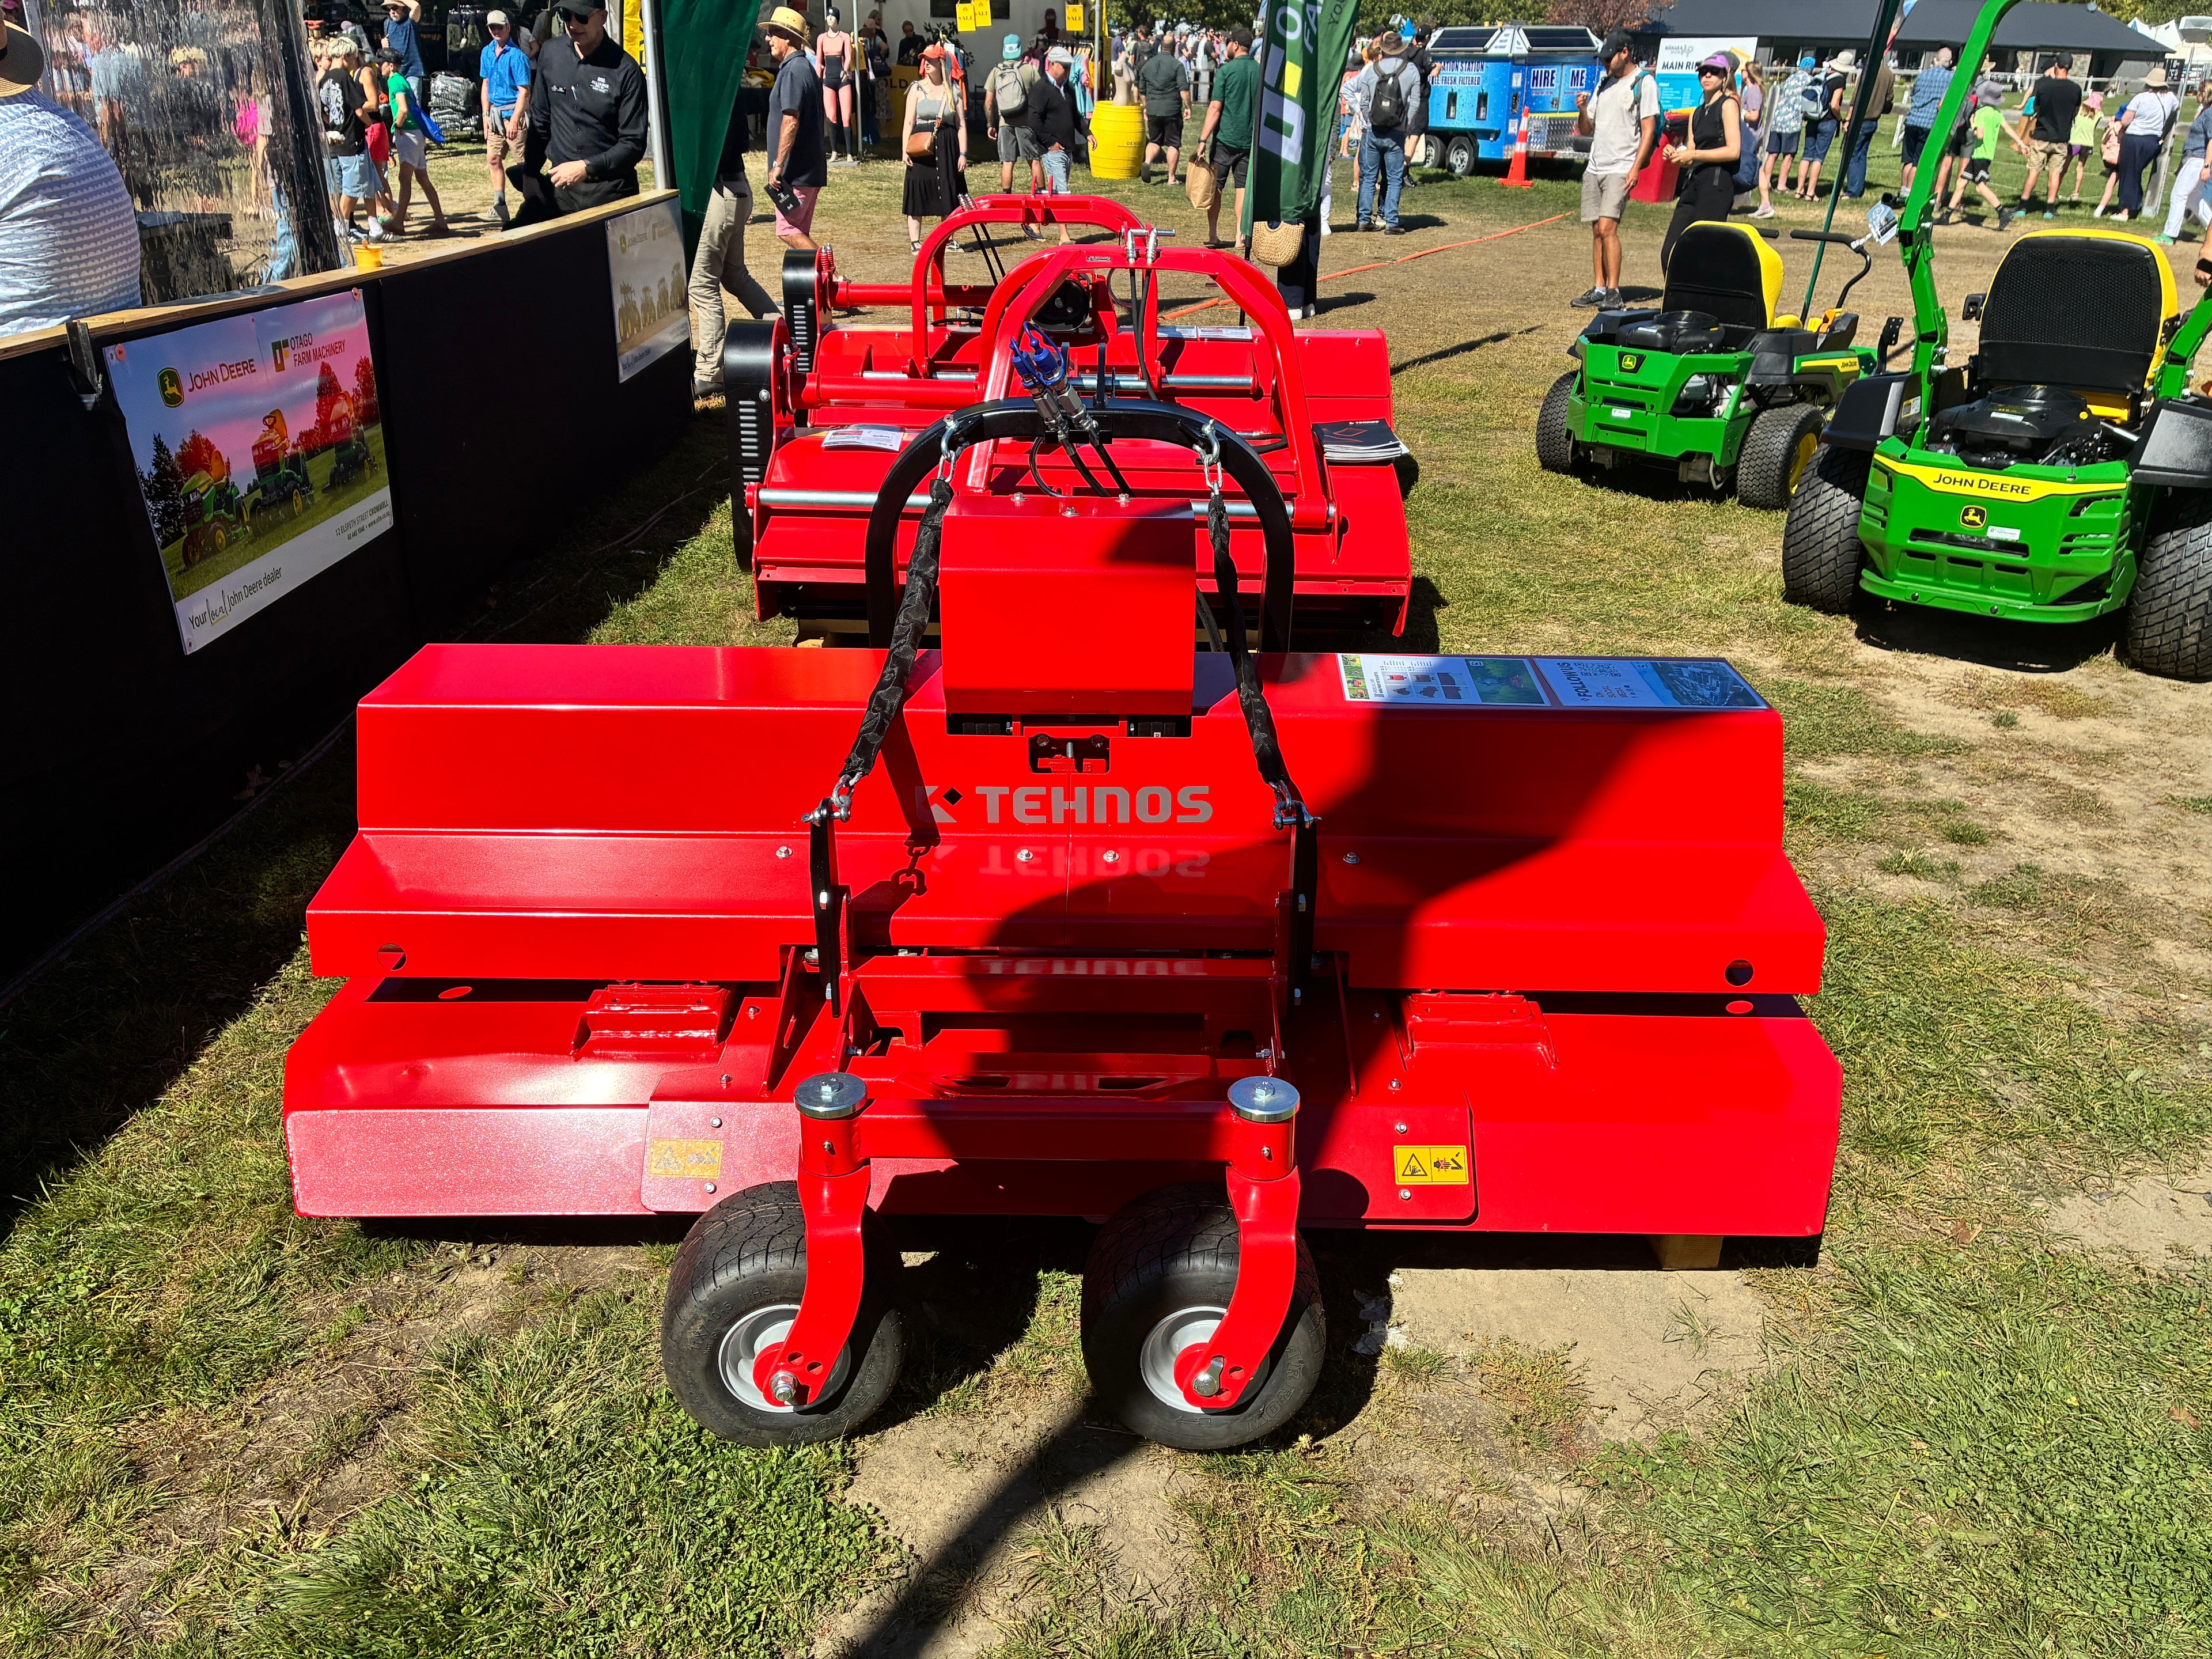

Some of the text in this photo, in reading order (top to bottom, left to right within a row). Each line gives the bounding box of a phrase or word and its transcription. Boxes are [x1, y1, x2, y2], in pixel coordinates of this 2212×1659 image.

[1441, 76, 1457, 85] FRESH
[1459, 76, 1480, 85] FILTERED
[1460, 62, 1484, 72] STATION
[1532, 70, 1556, 88] HIRE
[1570, 69, 1586, 88] ME
[1662, 61, 1684, 70] MAIN
[290, 333, 313, 350] OTAGO
[293, 339, 346, 368] FARM MACHINERY
[188, 358, 256, 392] JOHN DEERE
[1933, 474, 2031, 495] JOHN DEERE
[335, 499, 388, 536] 12 ELSPETH STREET CROMWELL
[188, 567, 282, 630] Your local John Deere dealer
[1556, 662, 1593, 697] FOLLOW US
[976, 786, 1213, 824] TEHNOS
[788, 1367, 880, 1441] ARROW
[1246, 1344, 1305, 1433] ARROW
